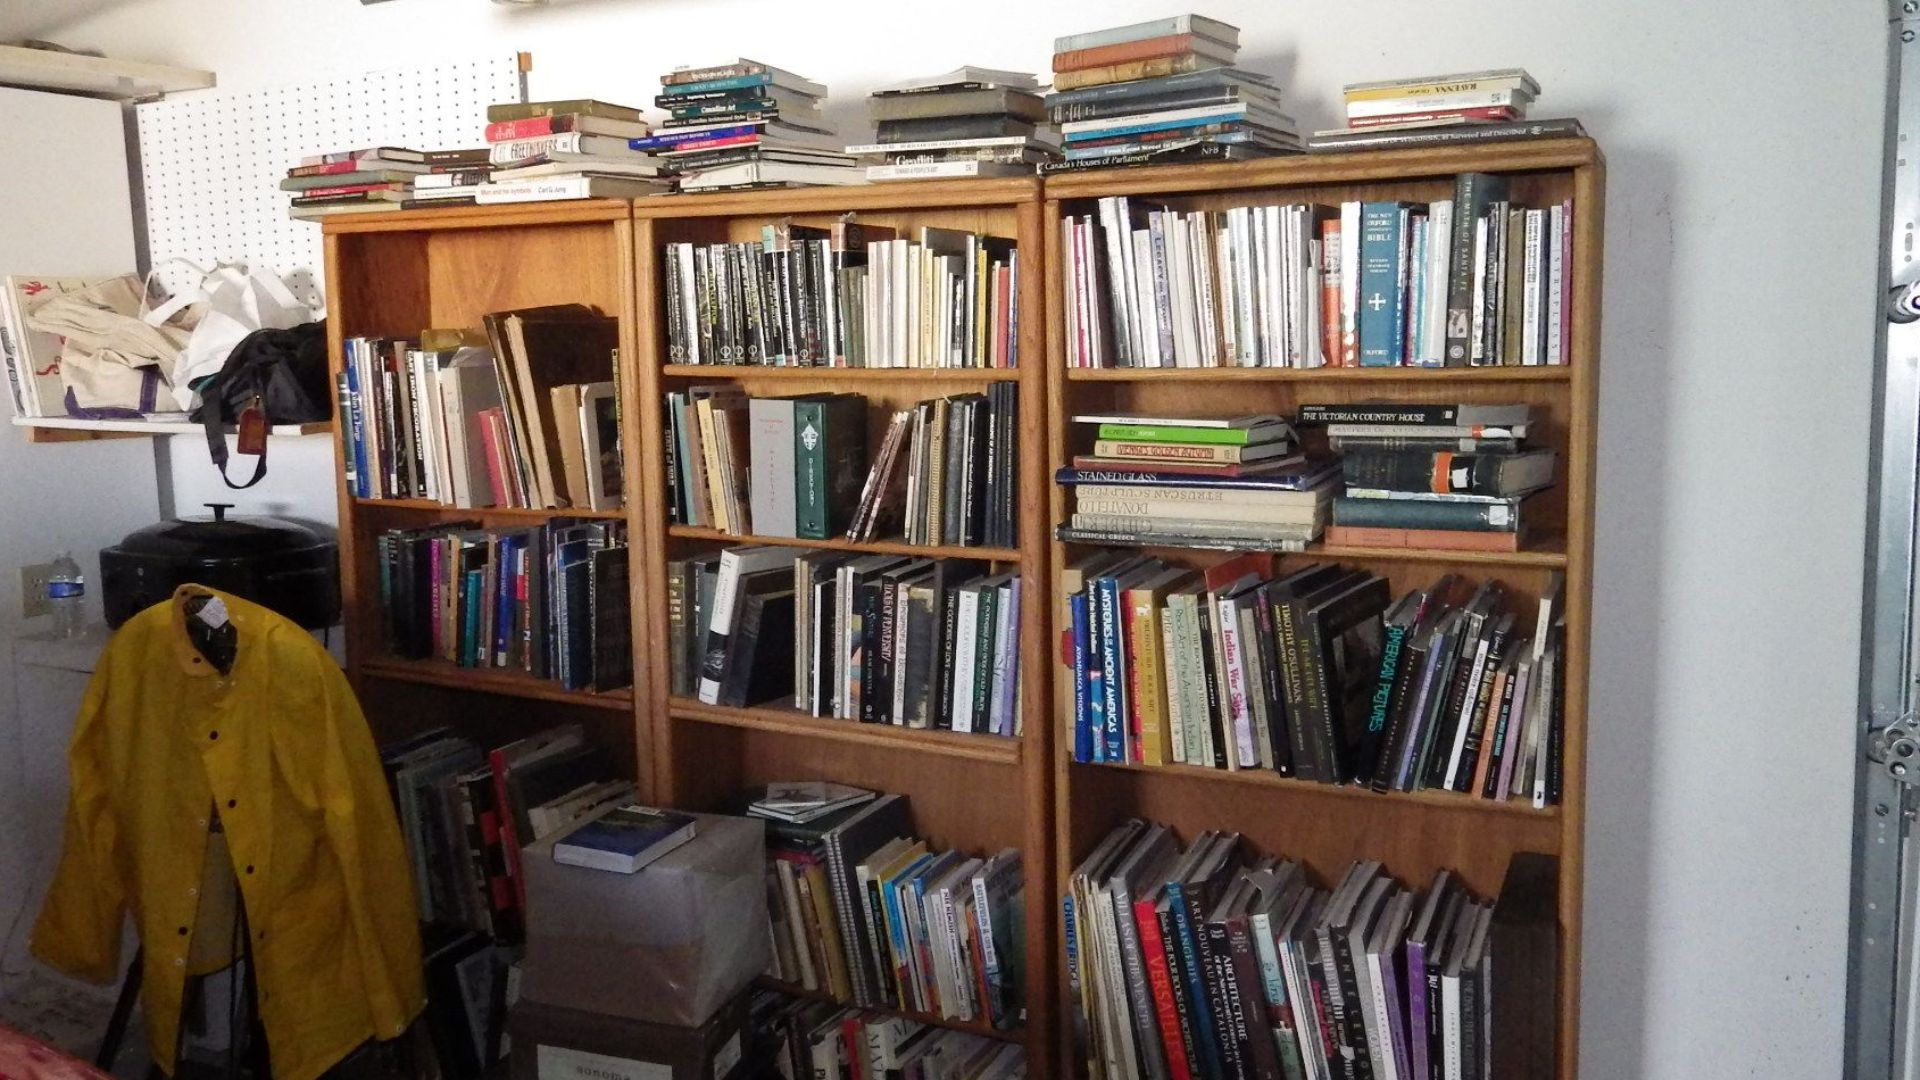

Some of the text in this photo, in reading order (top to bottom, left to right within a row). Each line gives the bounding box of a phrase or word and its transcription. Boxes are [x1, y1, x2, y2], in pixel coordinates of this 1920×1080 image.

[1435, 83, 1477, 94] RAVENNA
[1044, 160, 1076, 171] Canada's
[1076, 159, 1100, 168] Houses
[1110, 153, 1149, 164] Parliament
[1367, 233, 1392, 242] BIBLE
[1459, 181, 1472, 291] THE MYTH OF SANTA FE
[1154, 237, 1163, 279] LEGACY
[1551, 256, 1560, 351] STRAPLESS
[351, 391, 363, 442] John La Farge
[407, 350, 424, 461] CAST IRON DECORATION
[1303, 412, 1426, 423] THE VICTORIAN COUNTRY HOUSE
[664, 429, 675, 486] STATE WAR
[1076, 470, 1158, 482] STAINED GLASS
[1078, 486, 1224, 501] ETRUSCAN SCULPTURE
[1079, 502, 1148, 514] DONATELLO
[1071, 531, 1135, 541] CLASSICAL GREECE
[881, 583, 894, 662] IDOLS OF PERVERSITY
[946, 595, 954, 610] THE
[945, 610, 954, 641] GODDESS
[1281, 604, 1295, 645] TIMOTHY
[945, 641, 952, 651] OF
[1101, 588, 1117, 733] MYSTERIES ANCIENT AMERICAS
[1224, 629, 1236, 664] Indian
[1230, 668, 1241, 690] War
[1075, 646, 1084, 721] AYAHUASCA VISIONS
[1175, 609, 1196, 751] Rock Art of the American Indian
[1317, 664, 1327, 699] AMERICAN
[1367, 627, 1404, 732] AMERICAN PICTURES
[1169, 692, 1180, 725] World
[1063, 902, 1079, 982] CHARLES BRIDGE
[1115, 891, 1150, 1028] VILLAS OF THE VENETO
[1175, 912, 1198, 984] ORANGERIES
[1214, 955, 1223, 965] of
[1190, 900, 1233, 1064] ART NOUVEAU IN CATALONIA
[1216, 964, 1225, 976] the
[1337, 933, 1356, 997] ANNIE
[1148, 955, 1181, 1065] VERSAILLES
[1164, 935, 1198, 1074] THE FOUR BOOKS OF ARCHITECTURE
[1217, 976, 1231, 1013] Nineteenth
[1222, 955, 1249, 1041] ARCHITECTURE
[1225, 1013, 1240, 1049] Century
[1367, 1027, 1382, 1062] WOMEN
